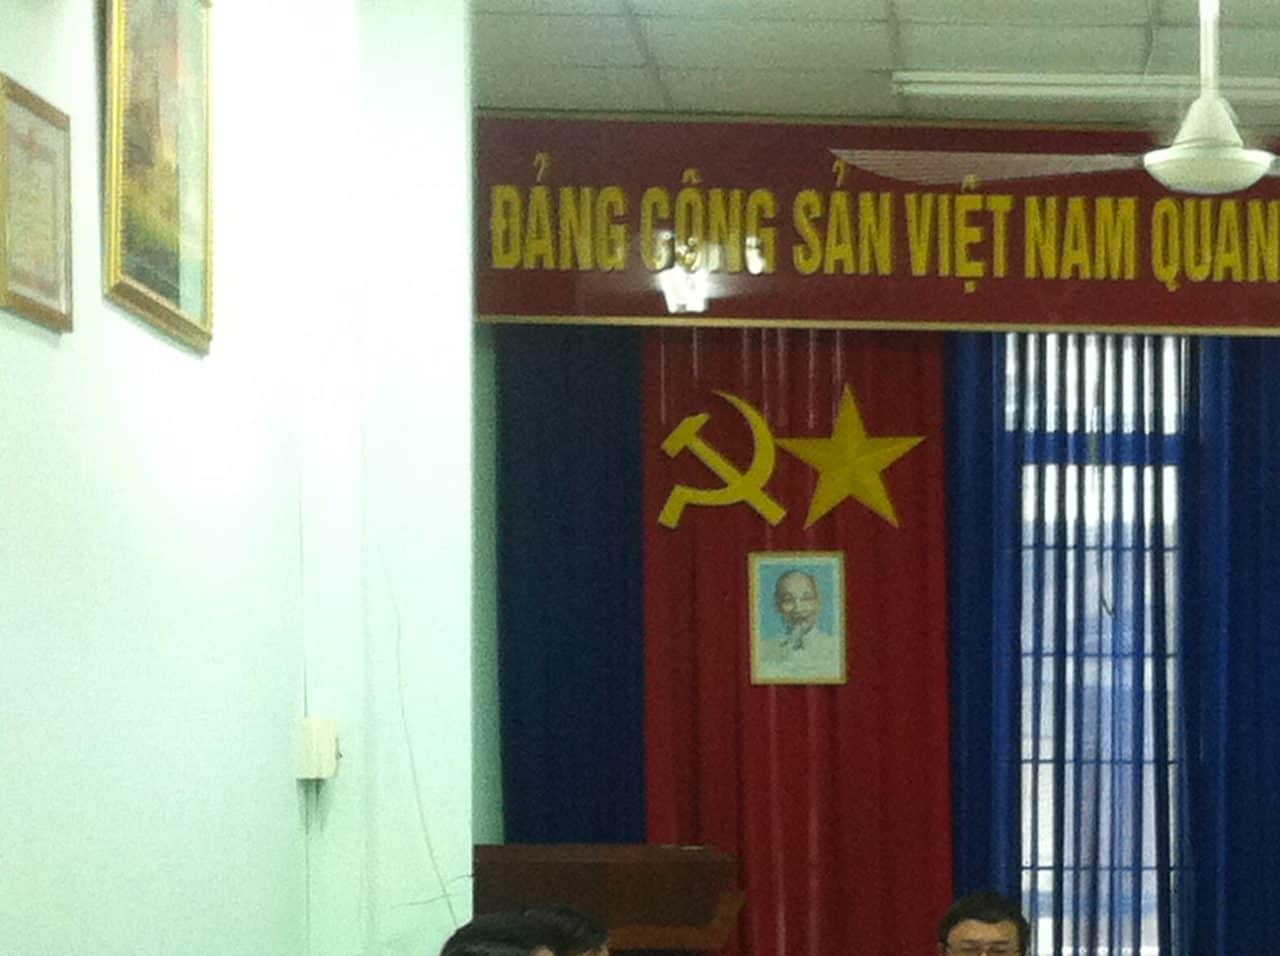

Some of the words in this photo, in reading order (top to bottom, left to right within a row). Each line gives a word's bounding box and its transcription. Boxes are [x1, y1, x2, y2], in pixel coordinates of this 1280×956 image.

[490, 152, 628, 272] ĐẢNG
[792, 158, 893, 276] SẢN
[904, 174, 1015, 293] VIỆT
[1024, 197, 1138, 281] NAM
